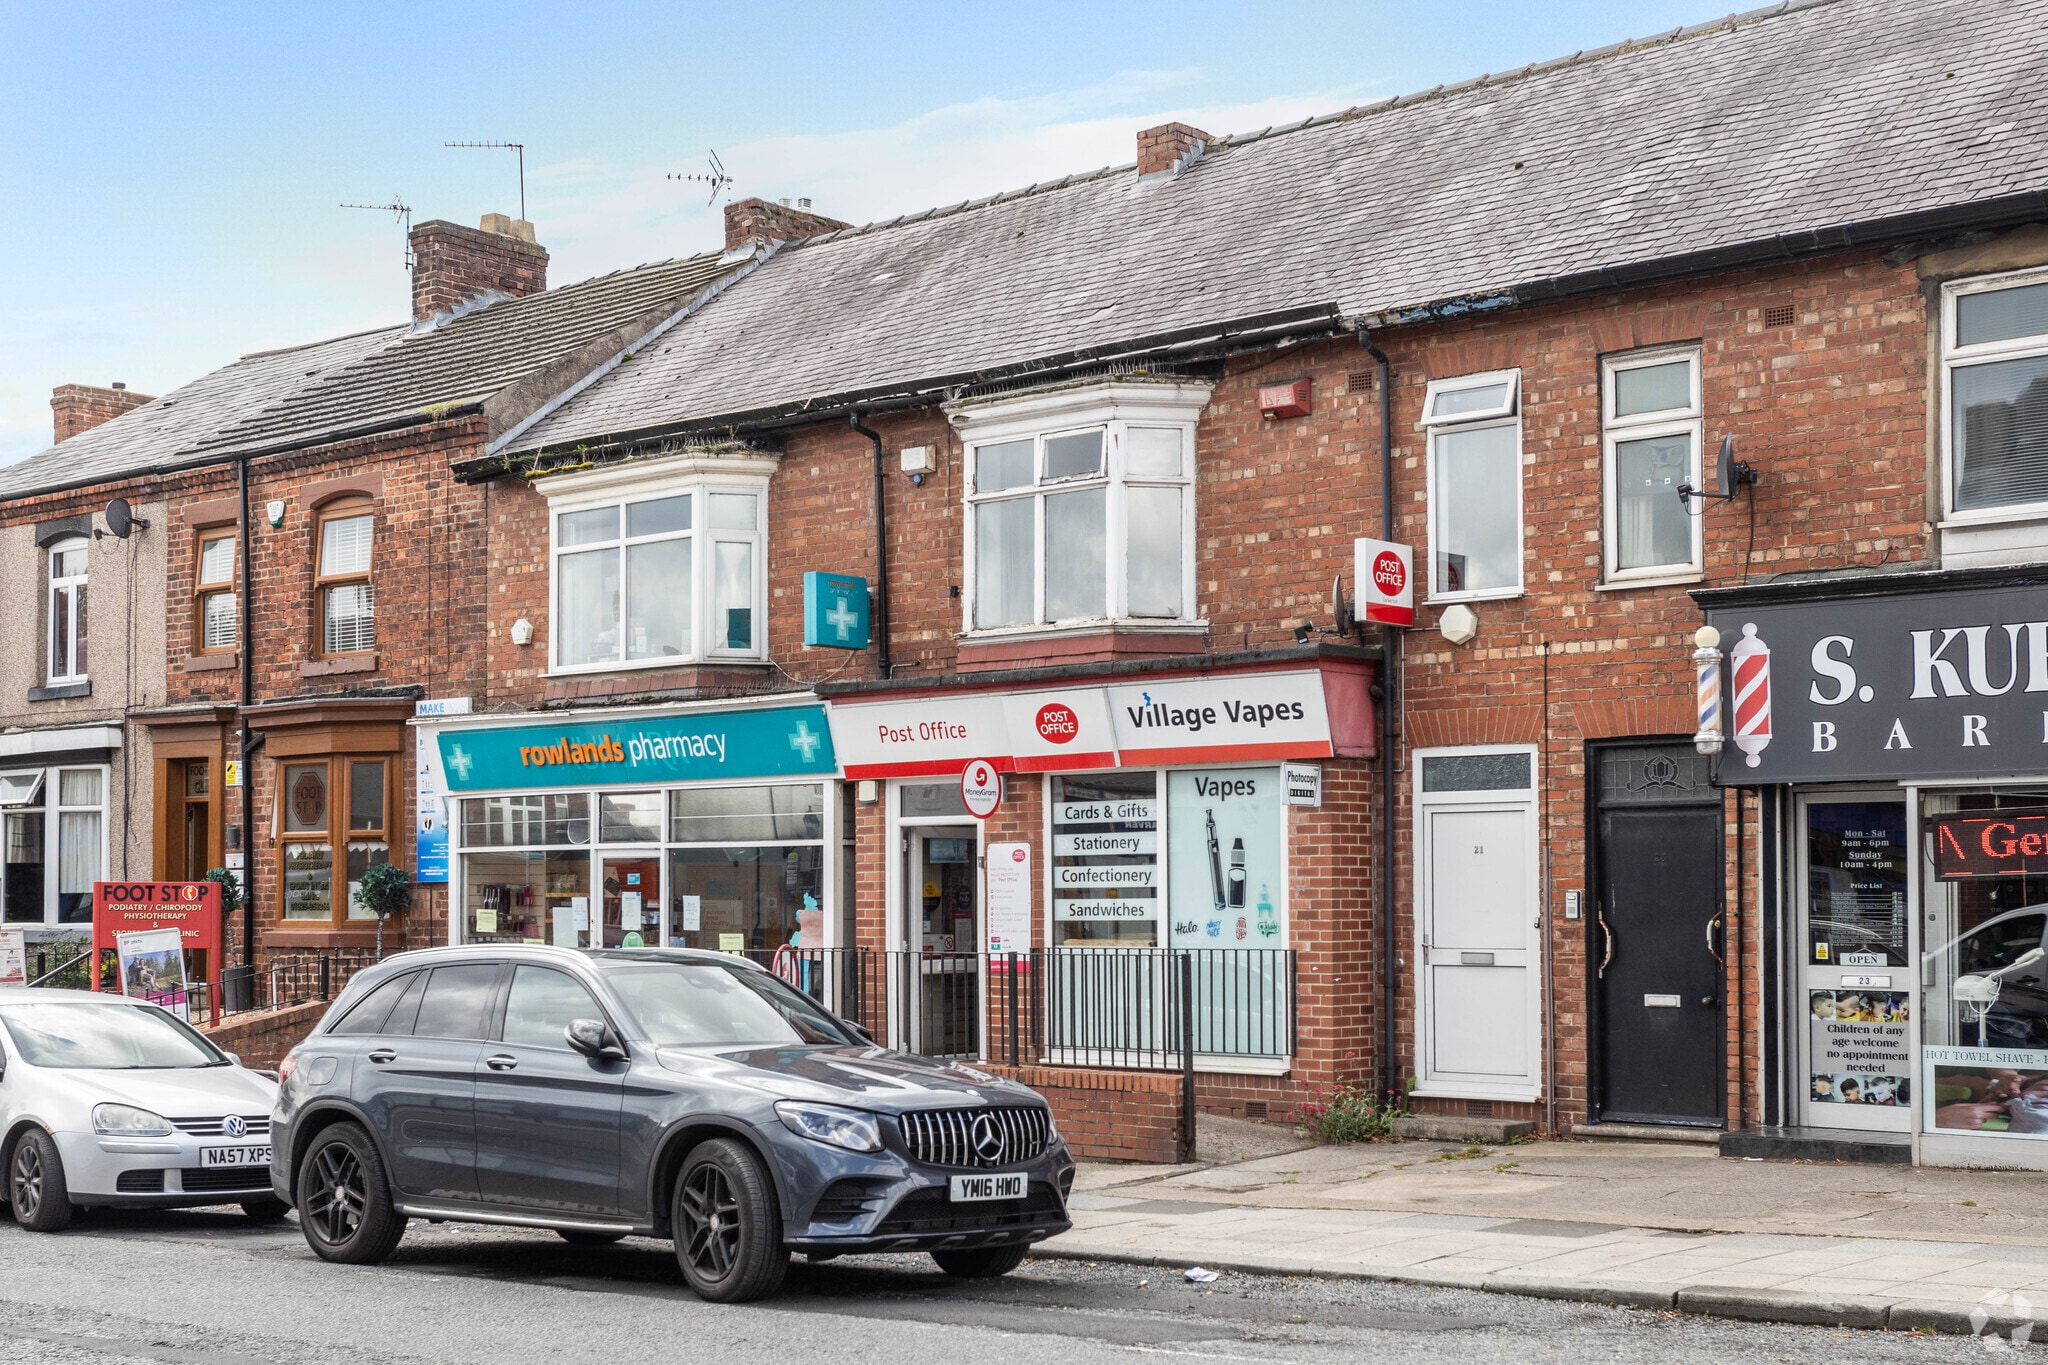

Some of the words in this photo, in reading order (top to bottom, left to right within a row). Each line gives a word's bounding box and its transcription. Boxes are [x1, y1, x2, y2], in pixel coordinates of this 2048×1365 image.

[1380, 559, 1400, 573] POST
[1375, 571, 1403, 587] OFFICE
[1809, 634, 1876, 705] S.
[419, 702, 445, 714] MAKE
[1043, 710, 1069, 723] POST
[1127, 698, 1217, 732] Village
[1222, 699, 1305, 728] Vapes
[878, 724, 915, 744] Post
[919, 720, 968, 742] Office
[1040, 721, 1076, 736] OFFICE
[1811, 710, 2048, 753] BAR
[519, 733, 625, 767] rowlands
[627, 731, 726, 768] pharmacy
[1287, 770, 1318, 787] Photocopy
[296, 786, 321, 799] FOOT
[965, 788, 997, 797] MoneyGram
[1194, 776, 1256, 801] Vapes
[1290, 788, 1315, 798] DIGITAL
[1064, 805, 1100, 820] Cards
[1103, 804, 1113, 819] &
[1117, 803, 1148, 818] Gifts
[1844, 830, 1863, 838] Mon
[1871, 829, 1886, 838] Sat
[1073, 836, 1140, 852] Stationery
[1473, 845, 1485, 855] 21
[1869, 839, 1890, 848] 6pm
[1848, 850, 1883, 860] Sunday
[1872, 861, 1893, 869] 4pm
[1061, 868, 1152, 886] Confectionery
[103, 885, 156, 902] FOOT
[161, 885, 209, 902] STOP
[108, 903, 148, 911] PODIATRY
[1069, 902, 1145, 917] Sandwiches
[124, 912, 188, 920] PHYSIOTHERAPY
[152, 921, 159, 929] &
[1848, 955, 1879, 964] OPEN
[1858, 976, 1870, 985] 23
[1826, 1024, 1870, 1034] Children
[1872, 1025, 1884, 1035] of
[1885, 1027, 1905, 1037] any
[1831, 1039, 1850, 1048] age
[1853, 1038, 1900, 1048] welcome
[1826, 1050, 1840, 1058] no
[1842, 1050, 1909, 1061] appointment
[1925, 1050, 1950, 1060] HOT
[1952, 1051, 1993, 1062] TOWEL
[1995, 1053, 2034, 1064] SHAVE
[1846, 1063, 1886, 1073] needed
[208, 1149, 245, 1164] NA57
[248, 1147, 272, 1163] XPS
[961, 1177, 993, 1198] YM16
